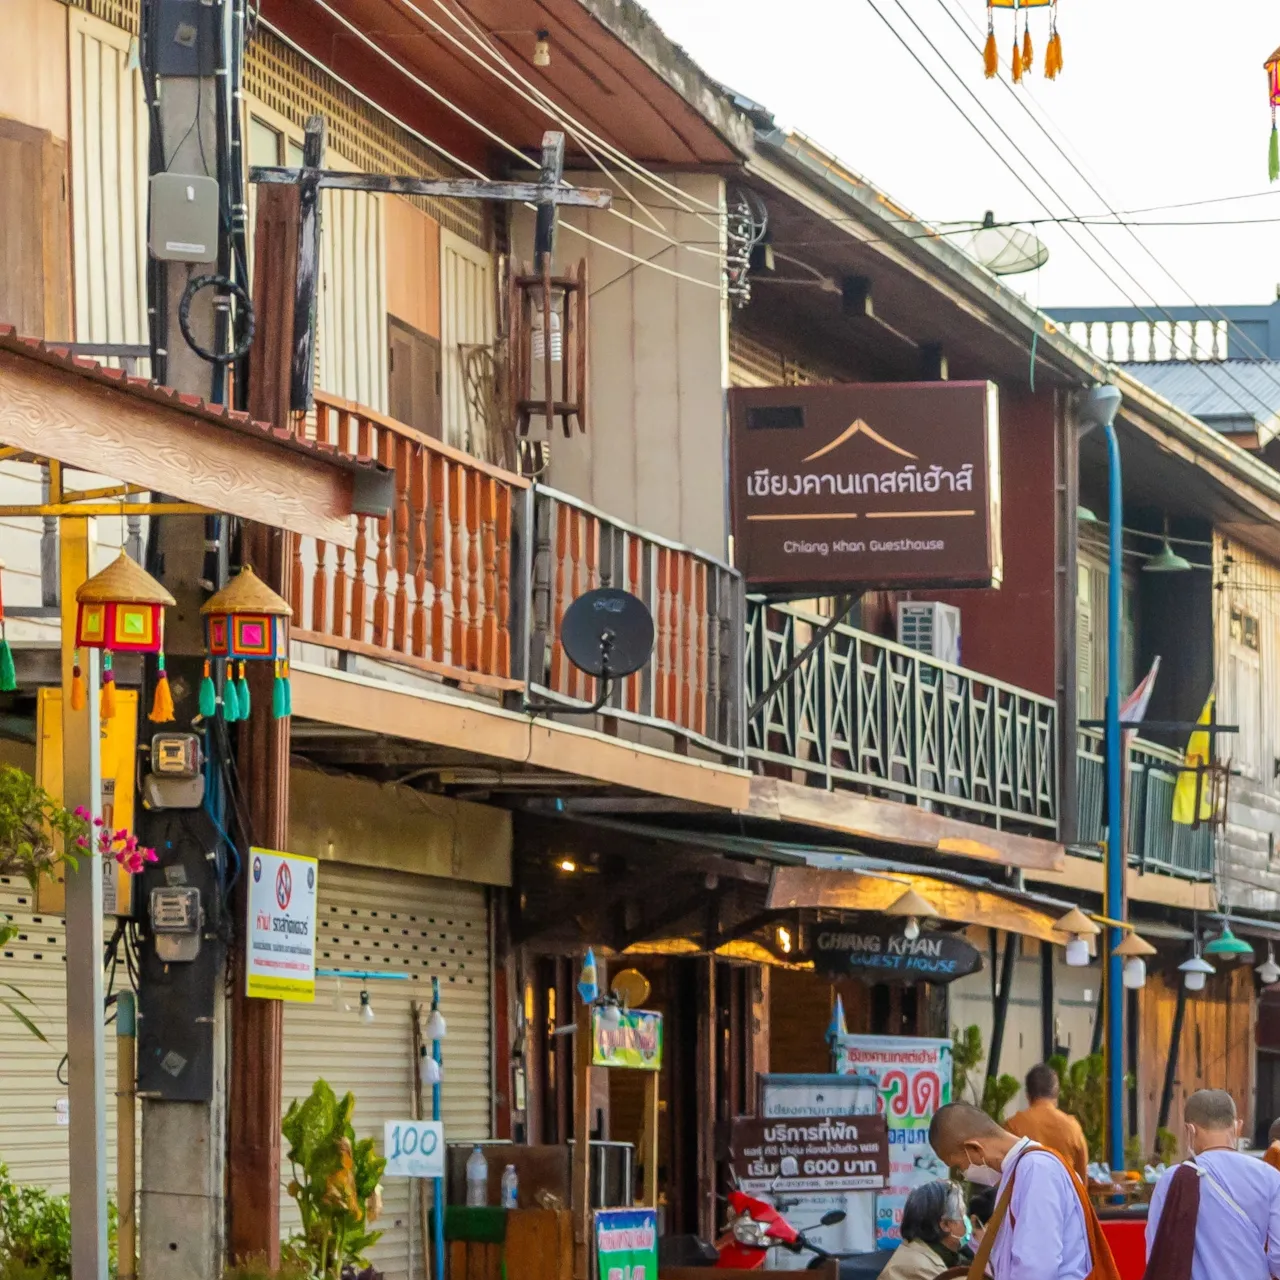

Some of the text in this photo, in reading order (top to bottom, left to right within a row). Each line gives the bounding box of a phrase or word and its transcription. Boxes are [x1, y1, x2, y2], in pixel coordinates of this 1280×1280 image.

[784, 537, 945, 556] Chiang Khan Guesthouse
[887, 935, 943, 957] KHAN
[850, 953, 957, 974] GUEST HOUSE
[391, 1126, 438, 1160] 100
[804, 1159, 840, 1175] 600
[844, 1159, 877, 1174] บาท
